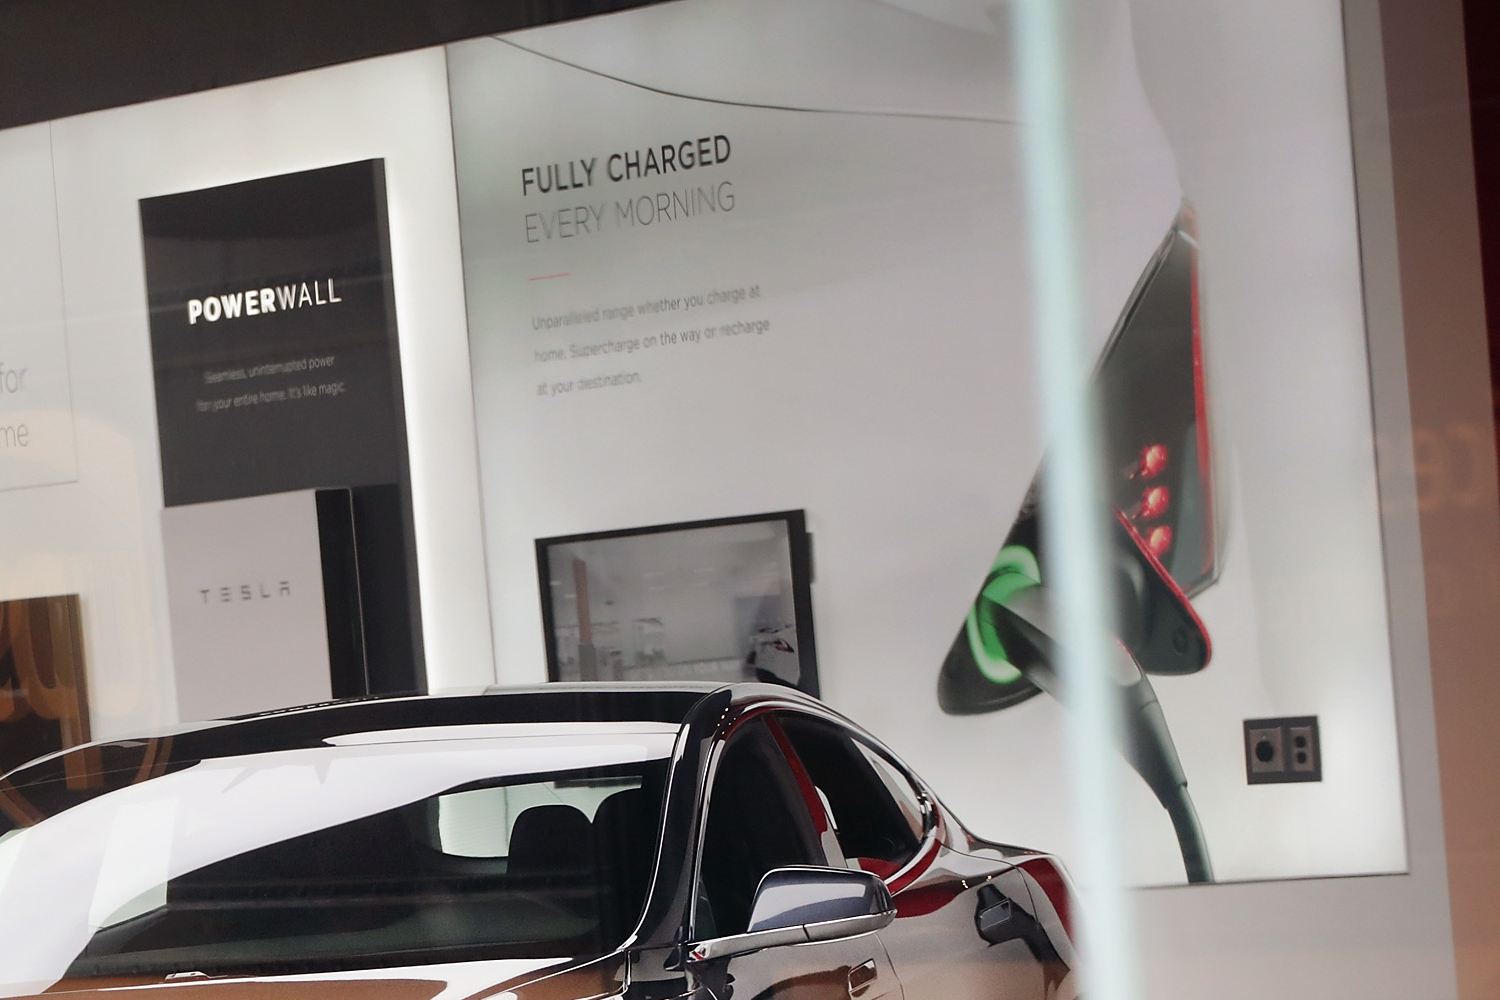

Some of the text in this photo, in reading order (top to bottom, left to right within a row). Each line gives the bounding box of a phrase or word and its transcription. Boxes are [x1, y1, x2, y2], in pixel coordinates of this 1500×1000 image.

[521, 134, 731, 196] FULLY CHARGED
[525, 181, 736, 243] EVERY MORNING
[188, 278, 343, 325] POWERWALL
[637, 297, 681, 315] whether
[684, 296, 704, 312] you
[706, 287, 746, 305] charge
[748, 284, 761, 299] at
[569, 338, 640, 359] Supercharge
[642, 335, 657, 349] on
[660, 330, 677, 346] the
[680, 329, 701, 344] way
[704, 327, 717, 340] or
[718, 319, 771, 336] recharge
[308, 355, 335, 371] power
[211, 398, 232, 413] your
[233, 394, 258, 408] entire
[302, 382, 317, 397] like
[536, 382, 548, 396] at
[551, 380, 574, 398] your
[199, 580, 291, 604] TESLA
